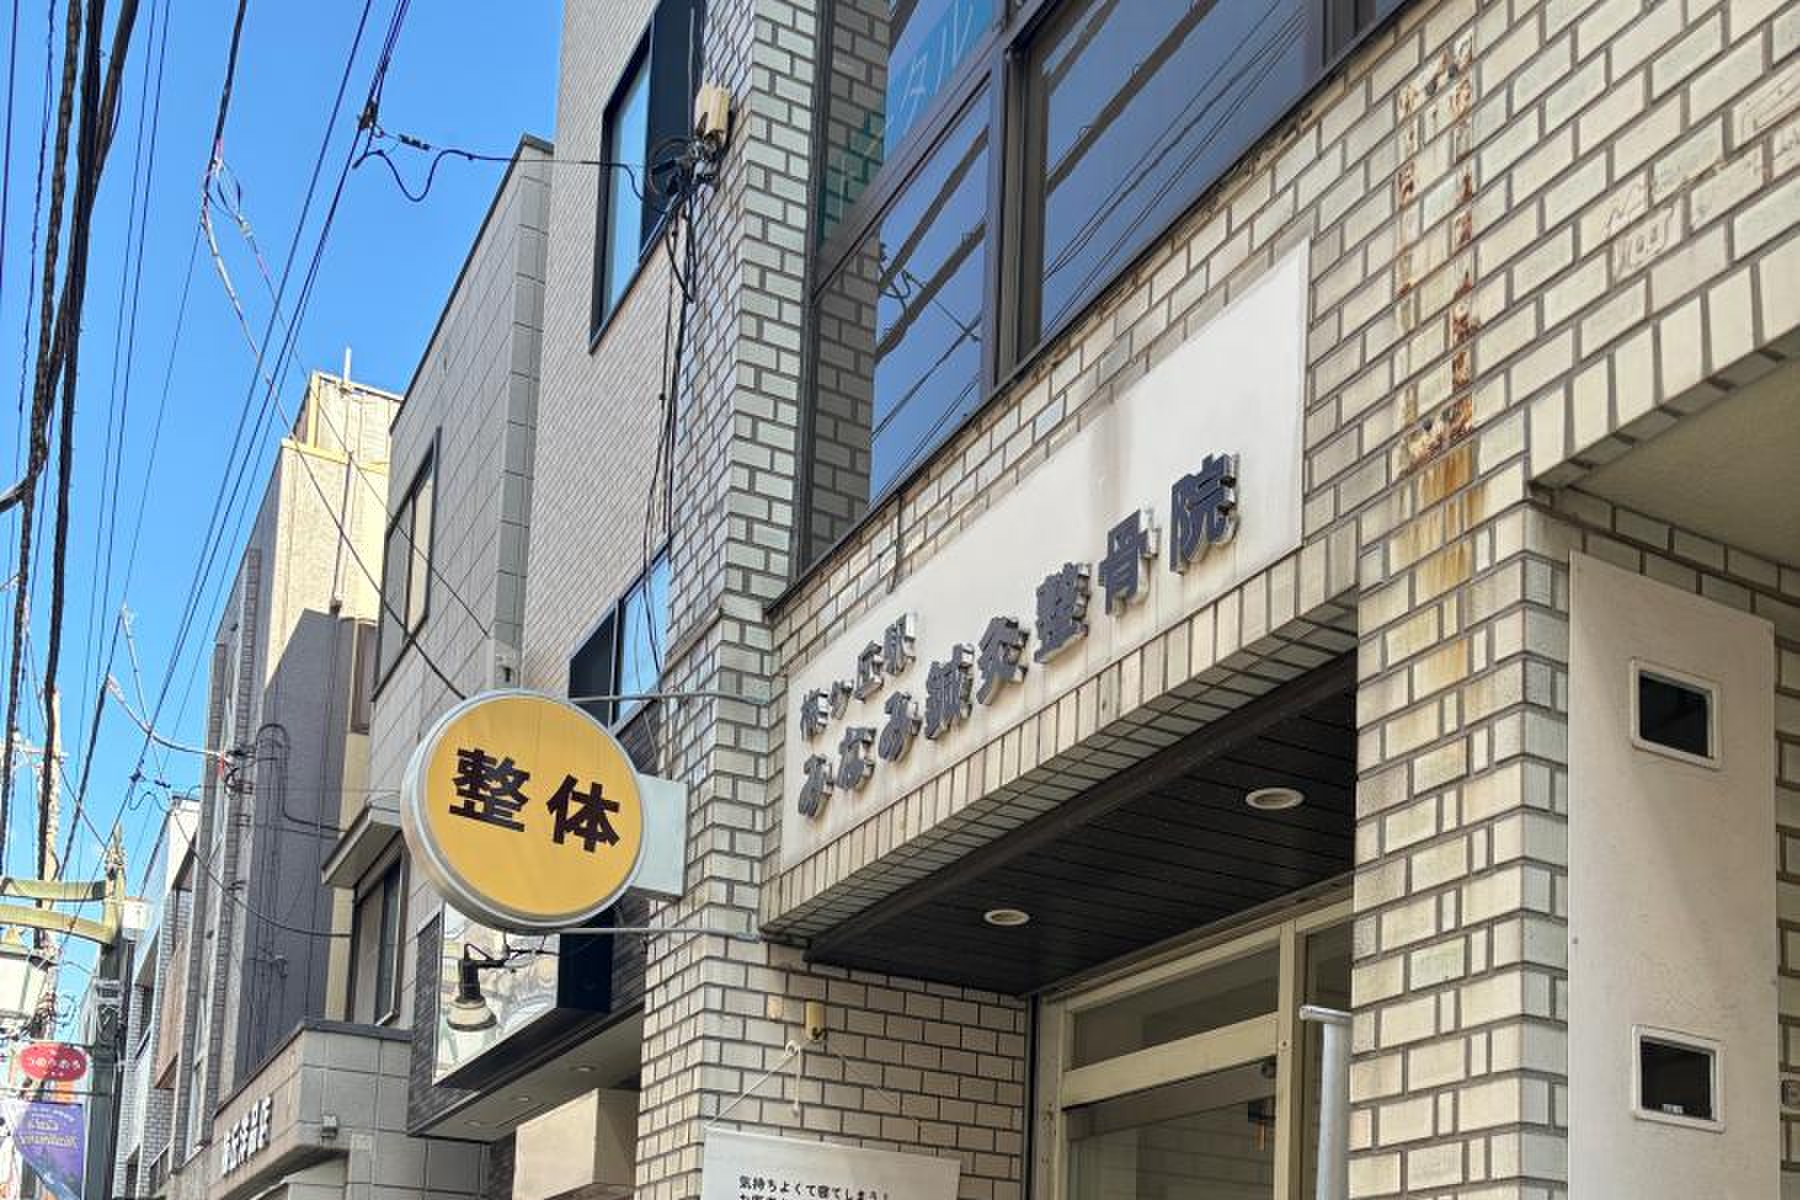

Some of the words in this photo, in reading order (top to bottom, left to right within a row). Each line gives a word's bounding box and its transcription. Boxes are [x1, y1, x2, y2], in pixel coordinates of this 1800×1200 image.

[798, 454, 1240, 818] みなみ鍼灸整骨院
[448, 748, 621, 853] 整体
